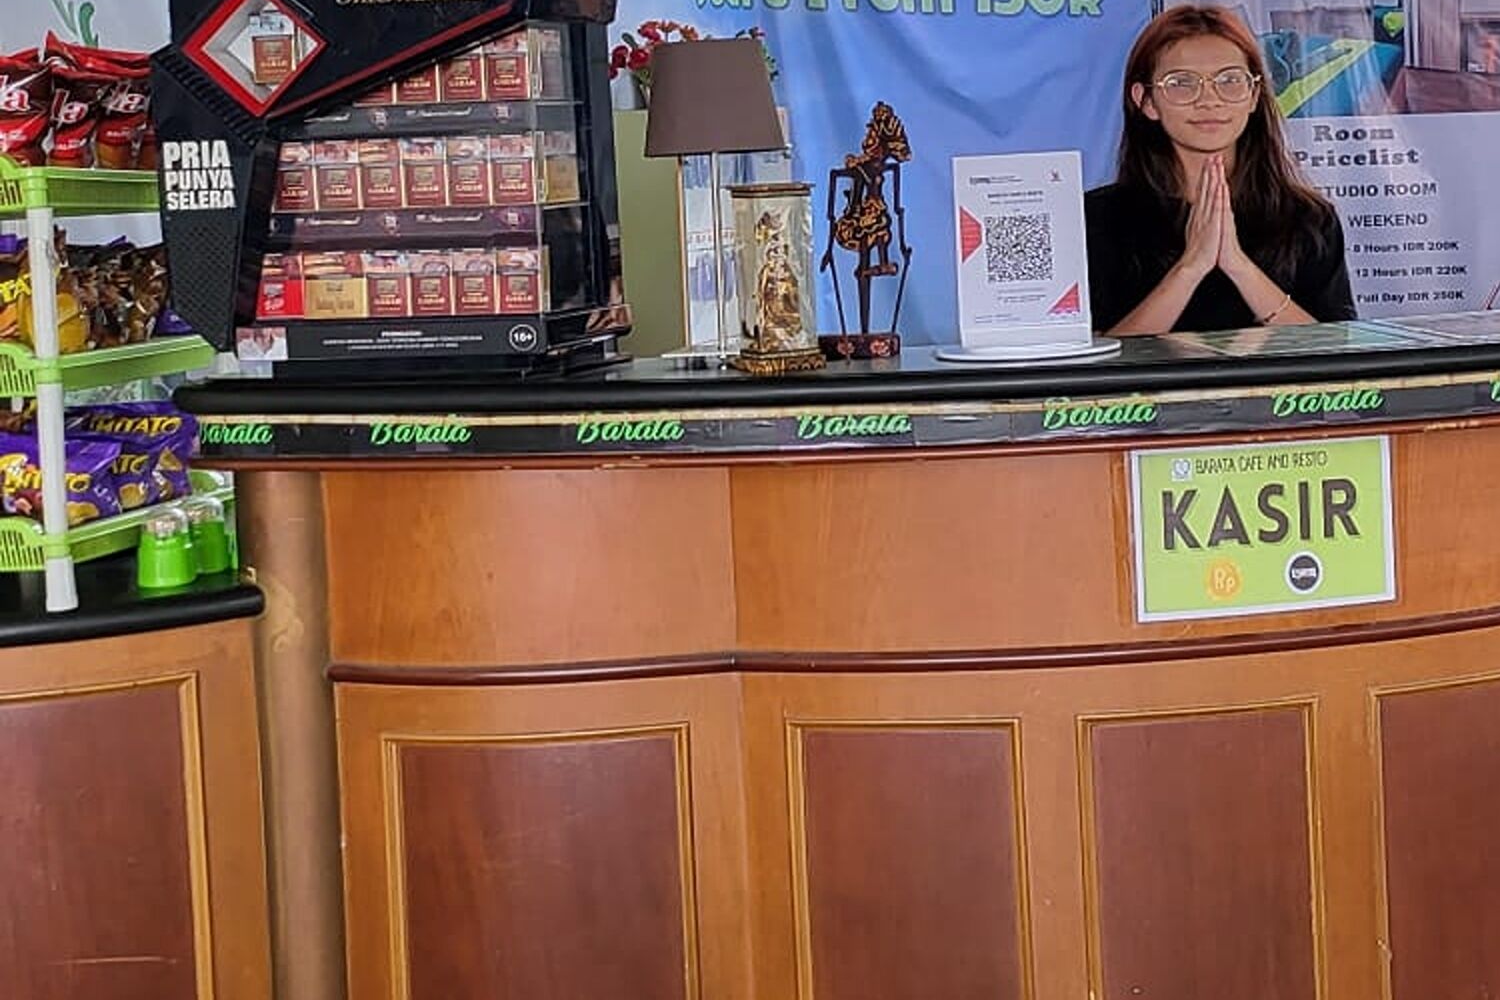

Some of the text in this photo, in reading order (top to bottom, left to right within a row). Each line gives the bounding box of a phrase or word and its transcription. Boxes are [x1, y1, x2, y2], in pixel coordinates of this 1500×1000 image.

[1313, 125, 1394, 141] Room
[162, 140, 231, 169] PRIA
[1294, 149, 1420, 167] Pricelist
[165, 170, 235, 191] PUNYA
[1314, 183, 1437, 198] TUDIO ROOM
[166, 190, 237, 210] SELERA
[1348, 214, 1428, 228] WEEKEND
[1364, 243, 1398, 253] Hours
[1373, 267, 1408, 277] Hours
[1412, 267, 1432, 276] IDR
[1382, 293, 1404, 304] Day
[1043, 395, 1157, 429] Barata
[1272, 387, 1383, 417] Barata
[370, 414, 472, 444] Barata
[576, 412, 684, 444] Barata
[797, 412, 912, 439] Barata
[1195, 450, 1328, 474] BARATA CAFE AND RESTO
[1161, 478, 1360, 550] KASIR
